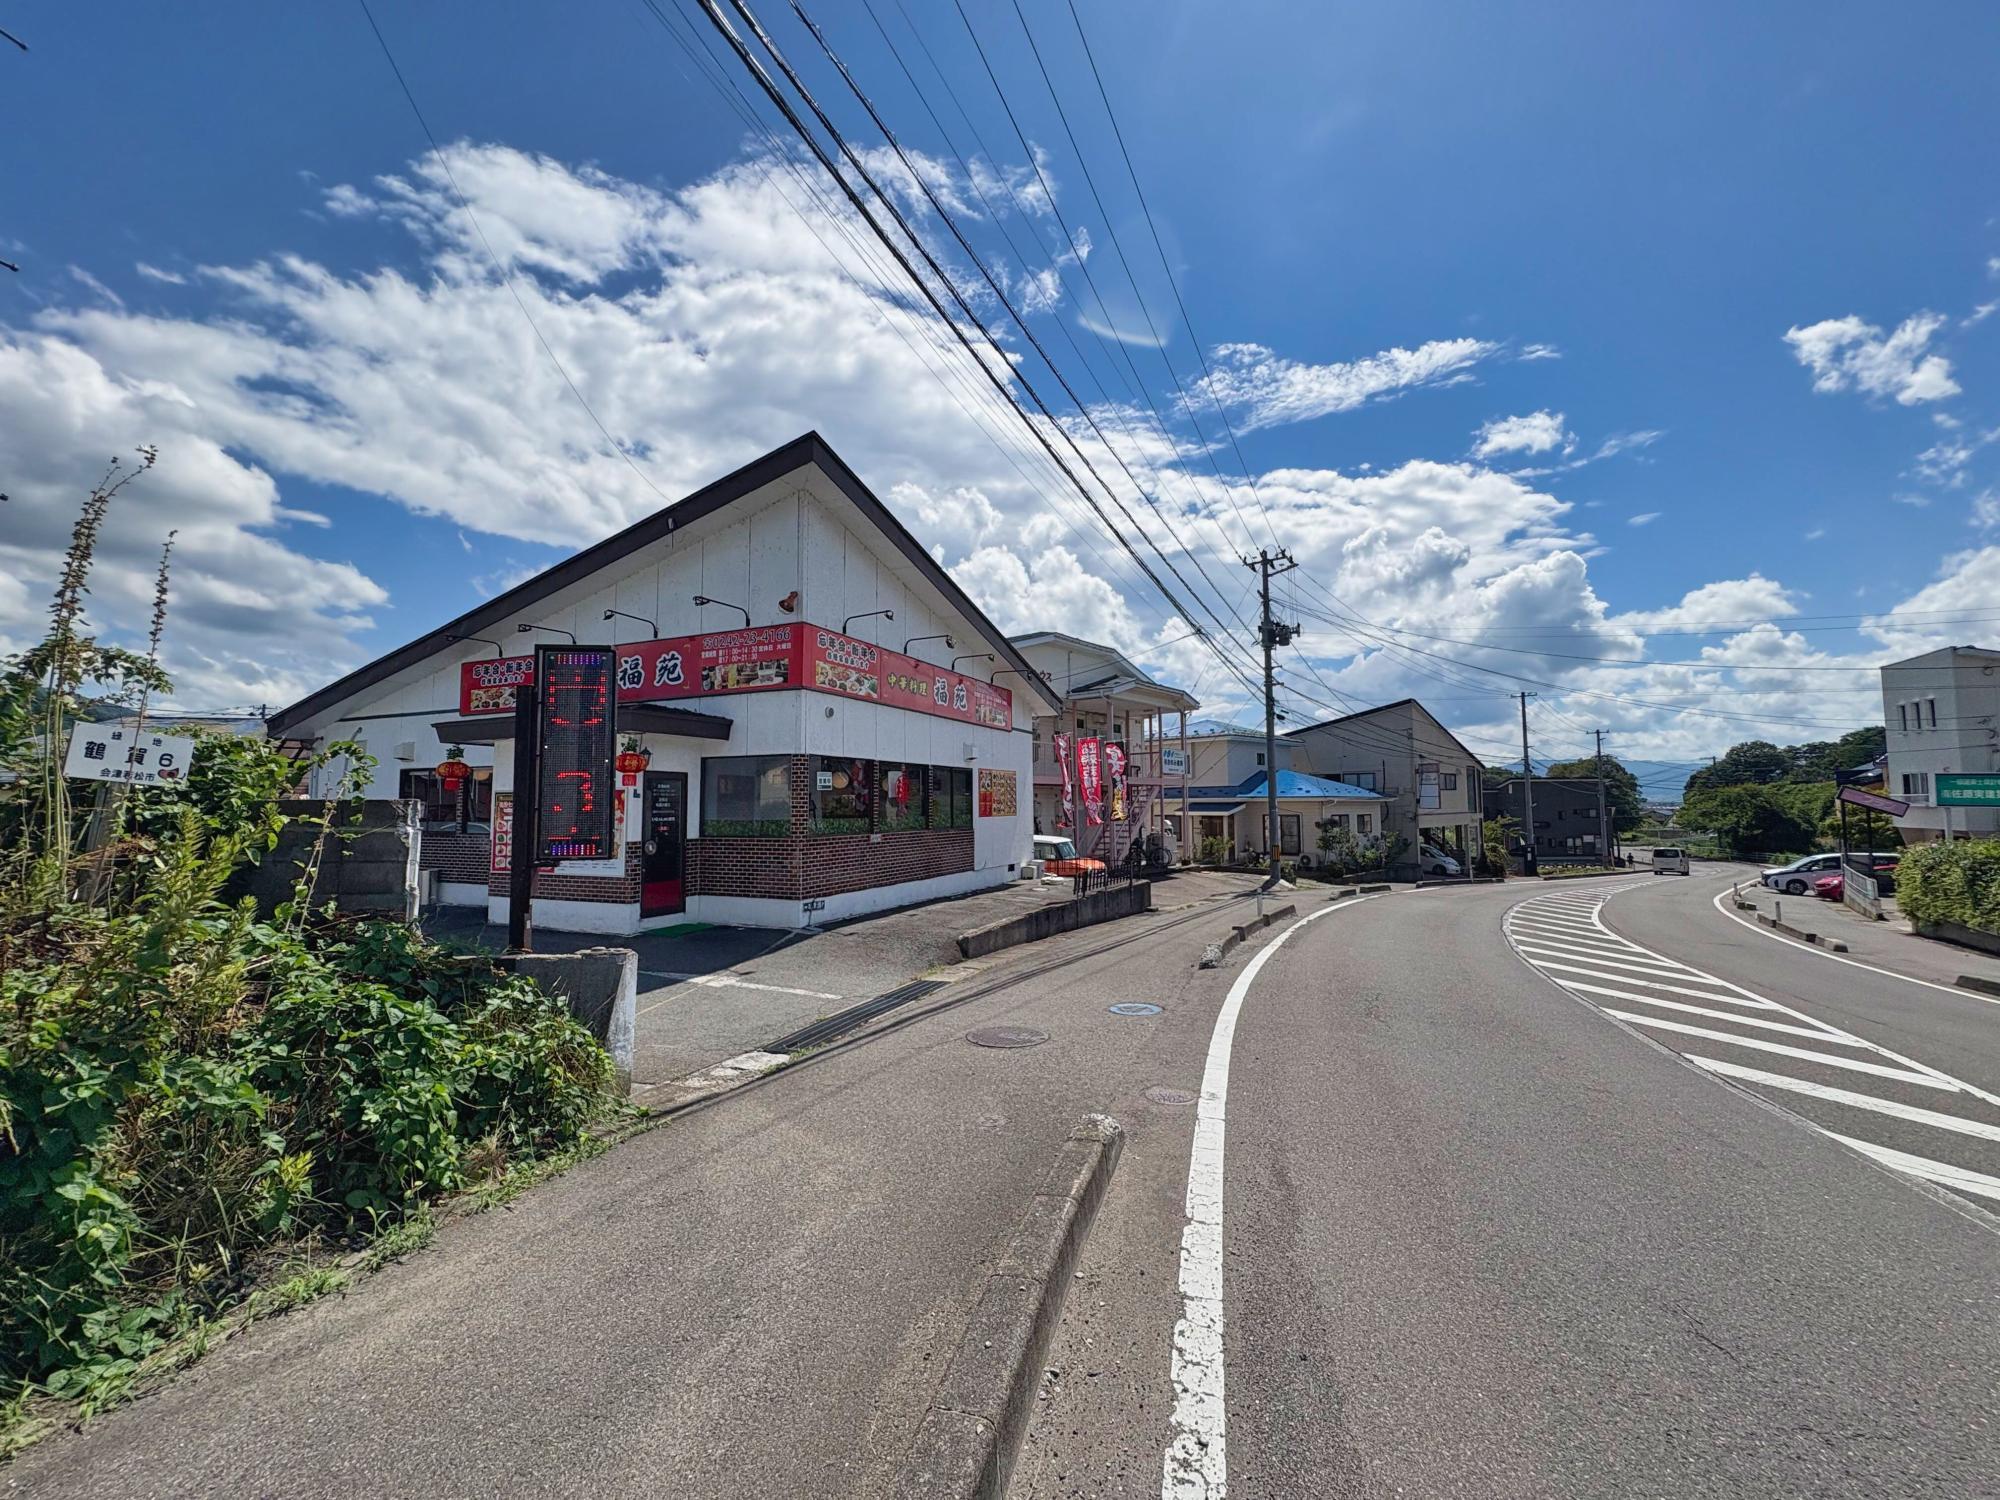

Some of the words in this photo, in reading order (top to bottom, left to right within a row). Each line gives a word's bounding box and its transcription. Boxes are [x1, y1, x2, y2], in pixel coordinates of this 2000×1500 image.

[712, 627, 791, 649] 0242-23-4166
[618, 651, 684, 689] 福苑
[887, 672, 928, 696] 中華料理
[934, 677, 968, 711] 福苑
